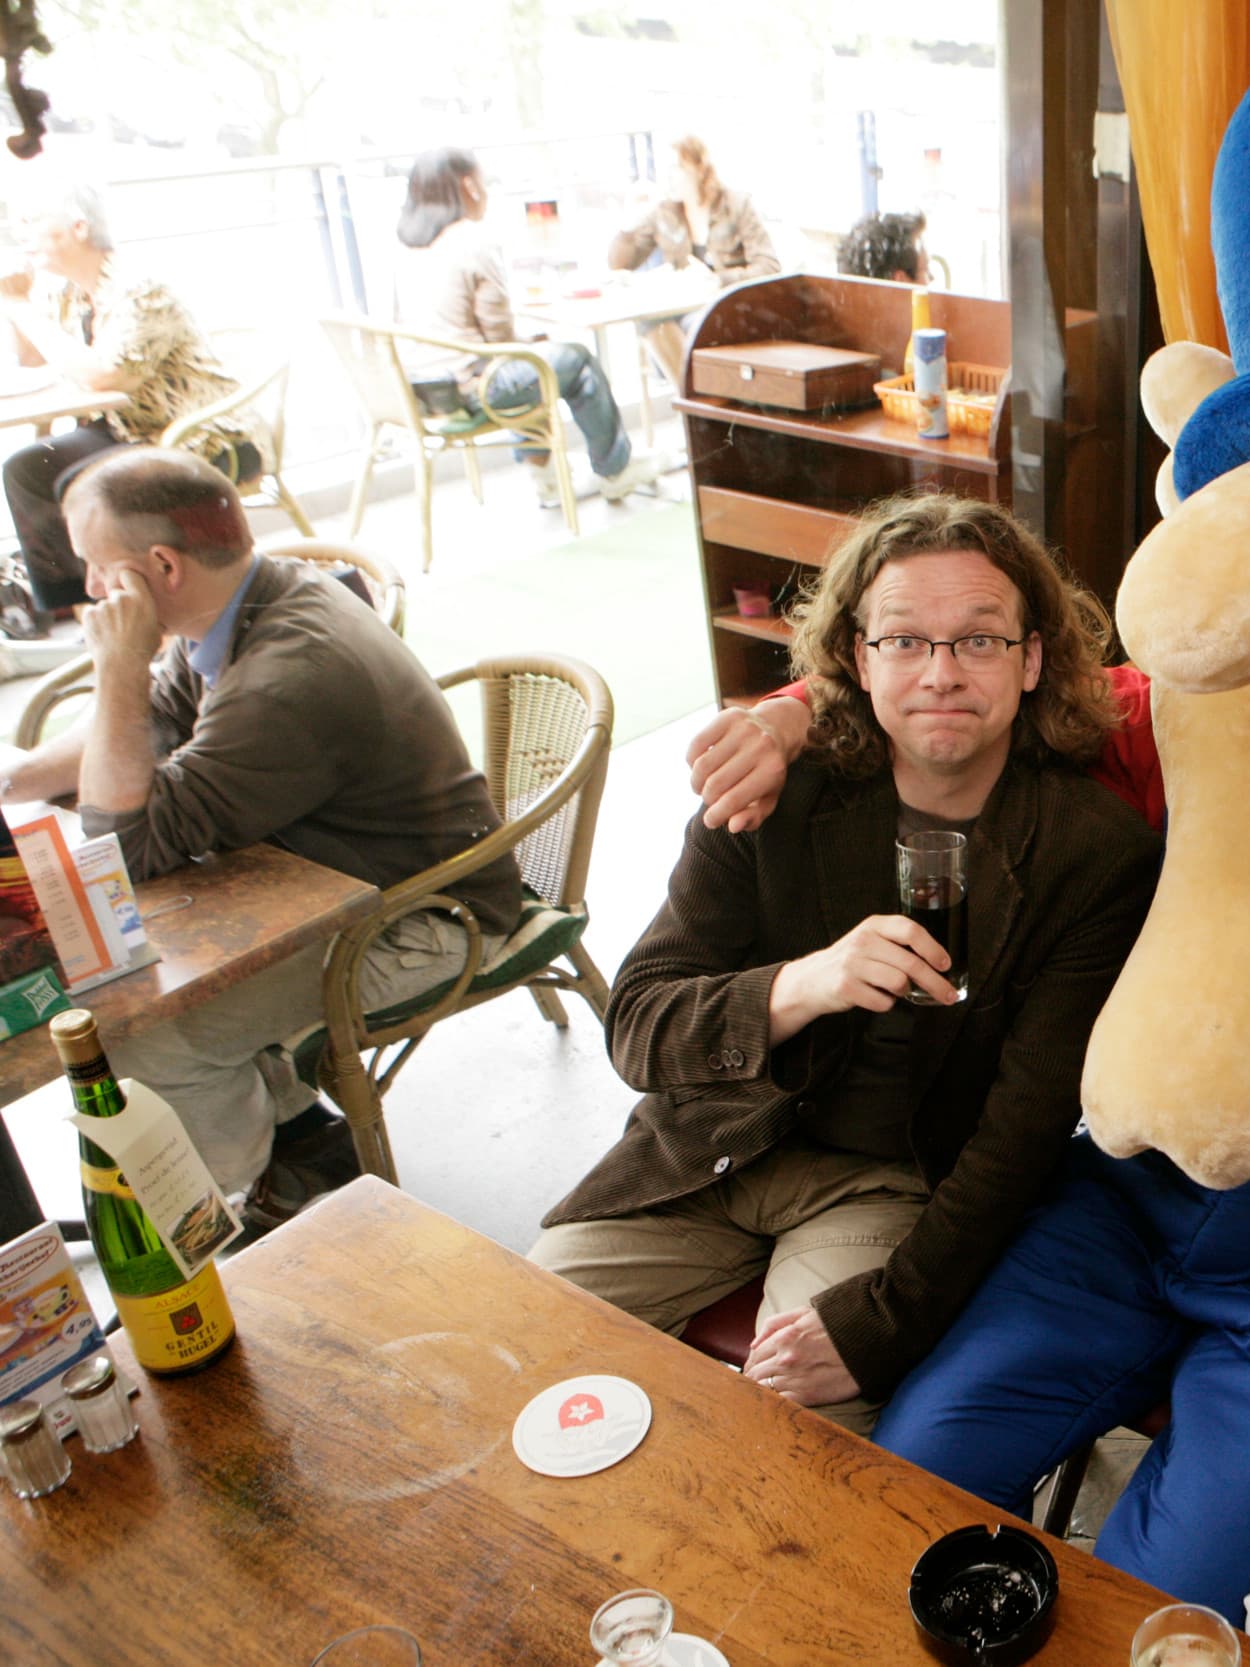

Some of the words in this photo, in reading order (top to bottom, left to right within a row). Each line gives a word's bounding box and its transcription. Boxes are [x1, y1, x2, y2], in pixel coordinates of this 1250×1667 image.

[155, 1283, 201, 1308] ALSACE
[165, 1320, 218, 1350] GENTIL
[178, 1335, 217, 1358] HUGEL
